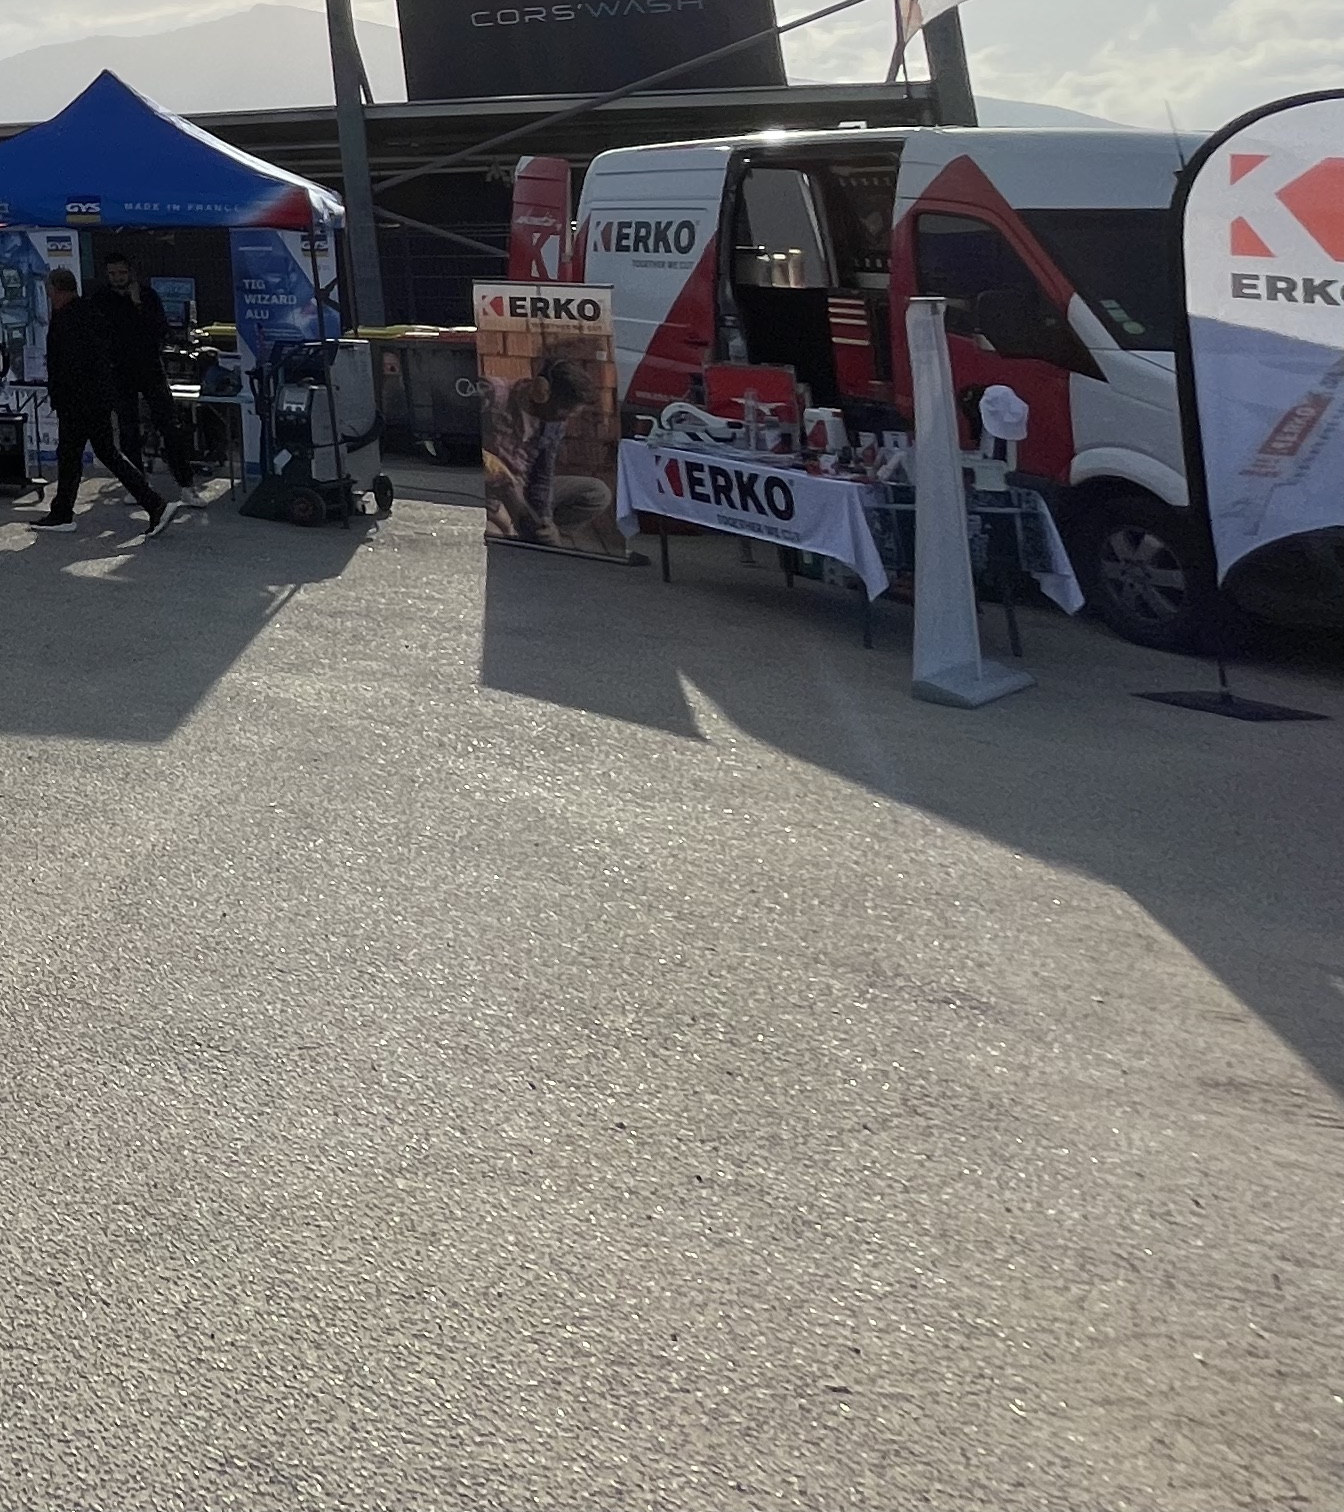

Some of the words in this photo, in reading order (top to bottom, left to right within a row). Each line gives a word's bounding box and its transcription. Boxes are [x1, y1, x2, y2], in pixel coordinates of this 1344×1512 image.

[66, 201, 101, 214] GYS
[124, 202, 160, 212] MADE
[615, 220, 696, 255] ERKO
[243, 279, 266, 290] TIG
[1232, 272, 1344, 307] ERK
[244, 294, 297, 305] WIZARD
[245, 309, 269, 320] ALU
[509, 296, 601, 322] ERKO
[685, 460, 795, 521] ERKO
